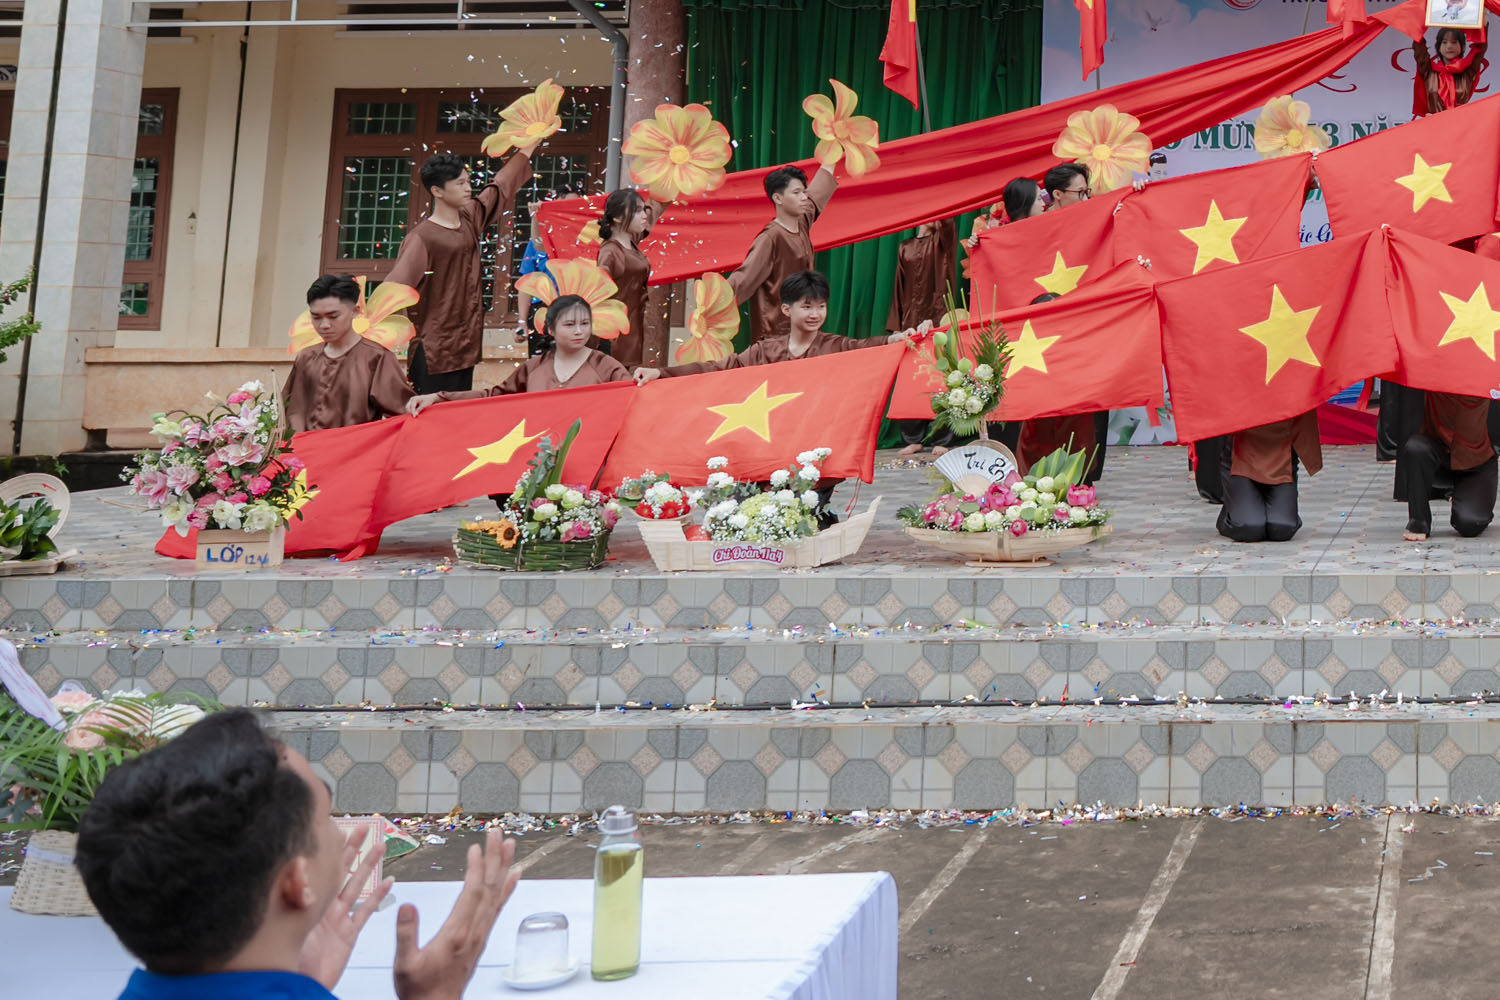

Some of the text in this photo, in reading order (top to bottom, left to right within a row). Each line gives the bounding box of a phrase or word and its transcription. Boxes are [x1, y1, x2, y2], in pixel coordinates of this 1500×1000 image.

[1194, 119, 1256, 150] MỪN
[207, 544, 244, 563] LỚP
[713, 548, 732, 563] Chi
